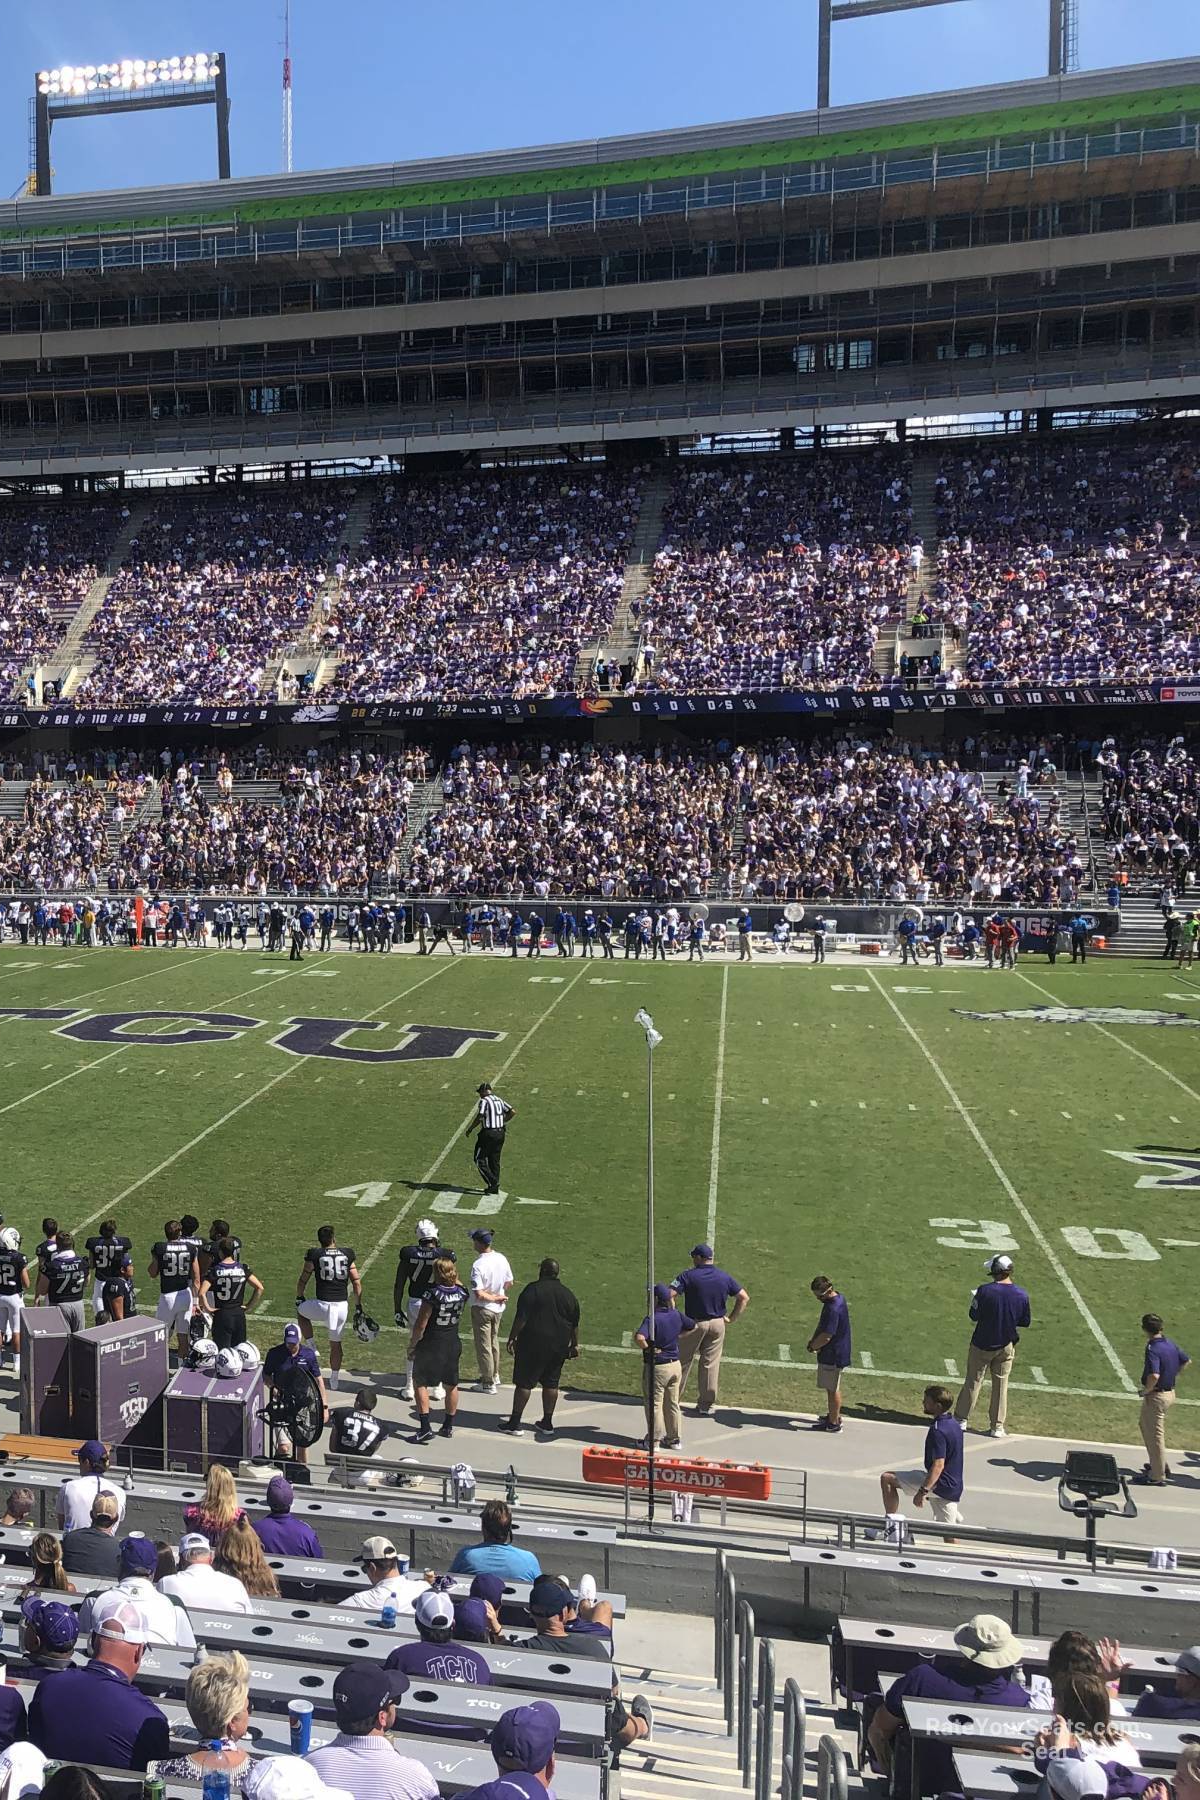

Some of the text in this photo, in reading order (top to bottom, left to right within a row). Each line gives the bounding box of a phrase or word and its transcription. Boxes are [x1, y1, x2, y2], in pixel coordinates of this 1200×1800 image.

[872, 696, 890, 707] 28
[941, 695, 956, 706] 13
[1026, 692, 1042, 703] 10
[1065, 692, 1076, 702] 4
[437, 704, 458, 712] 7:33
[825, 698, 840, 708] 41
[412, 708, 424, 716] 10
[491, 706, 502, 714] 31
[92, 714, 107, 724] 110
[128, 714, 146, 723] 198
[226, 712, 238, 720] 19
[323, 1181, 509, 1216] 40
[929, 1217, 1162, 1261] 30
[162, 1252, 192, 1277] 36
[319, 1257, 349, 1282] 86
[56, 1270, 85, 1295] 73
[216, 1276, 246, 1302] 37
[154, 1330, 166, 1342] 14
[100, 1341, 122, 1355] FIELD
[120, 1396, 148, 1420] TCU
[341, 1416, 380, 1452] 37
[624, 1464, 725, 1488] GATORADE
[304, 1566, 327, 1574] TCU
[329, 1615, 355, 1624] TCU
[204, 1621, 232, 1630] TCU
[426, 1655, 477, 1684] TCU
[466, 1698, 502, 1710] TCU
